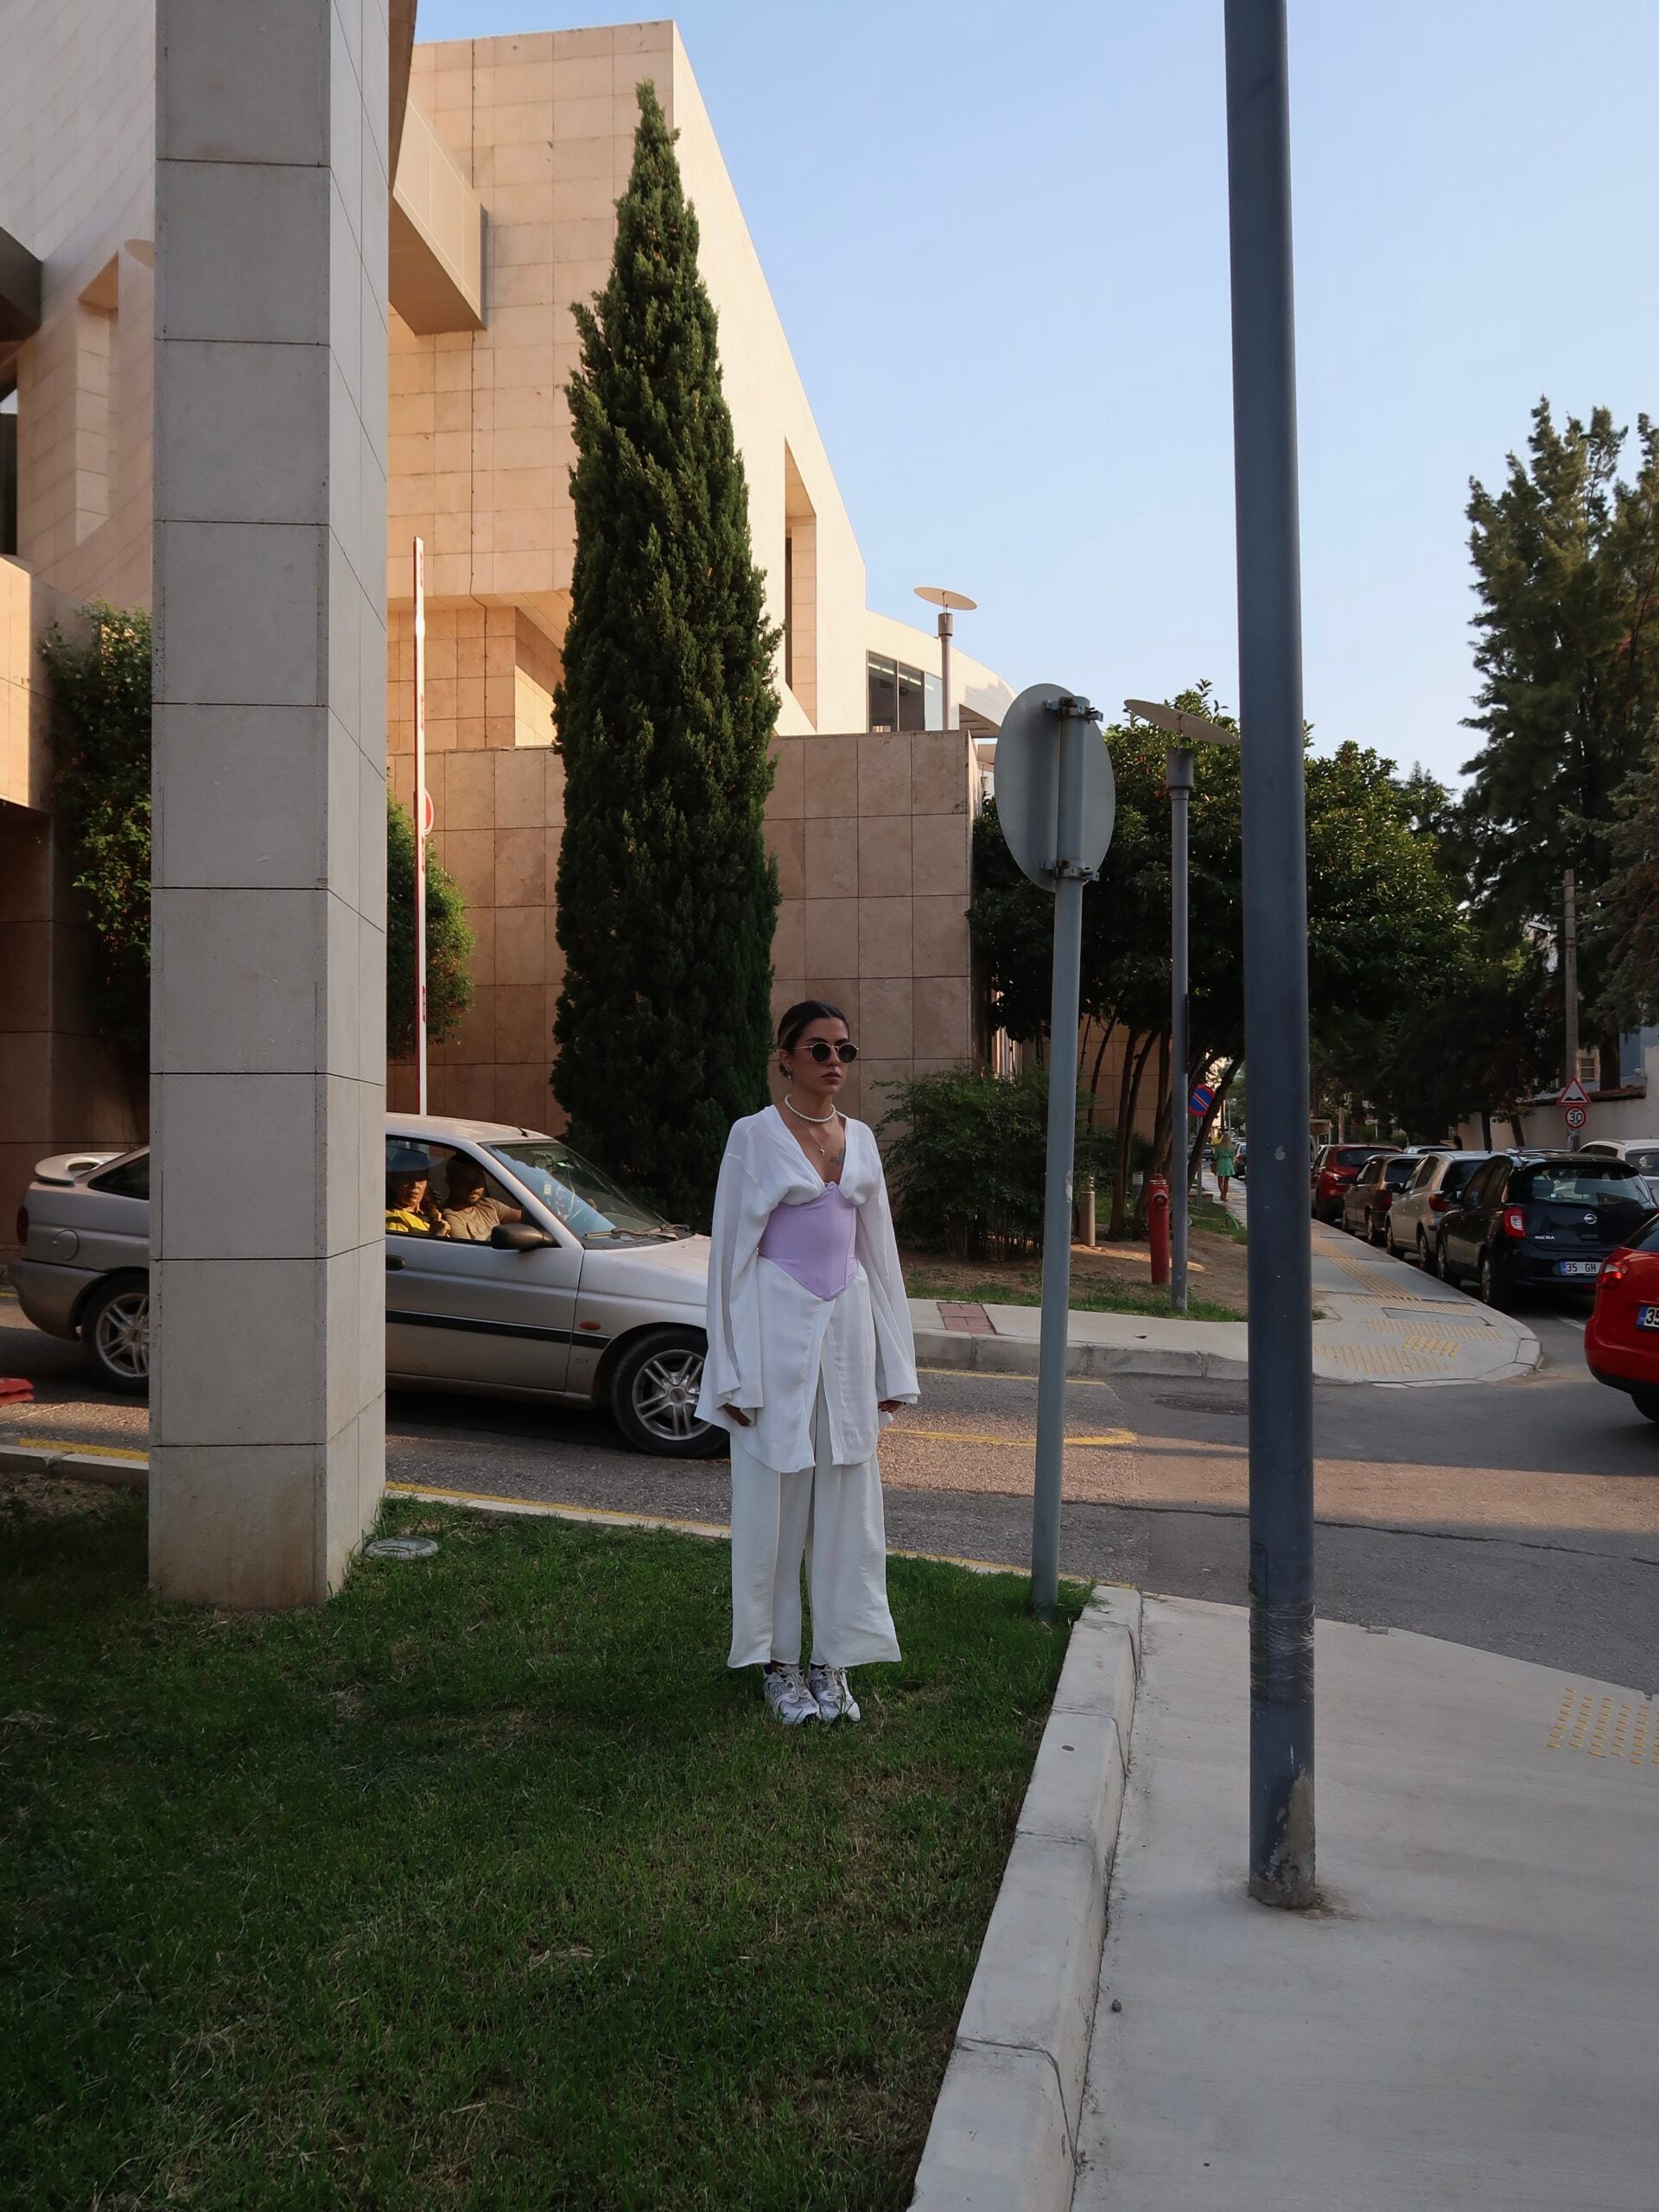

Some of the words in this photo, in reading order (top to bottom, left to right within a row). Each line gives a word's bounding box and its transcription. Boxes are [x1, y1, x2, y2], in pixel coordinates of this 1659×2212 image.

[1568, 1112, 1583, 1122] 30
[1566, 1262, 1578, 1273] 35
[1585, 1262, 1597, 1273] GH
